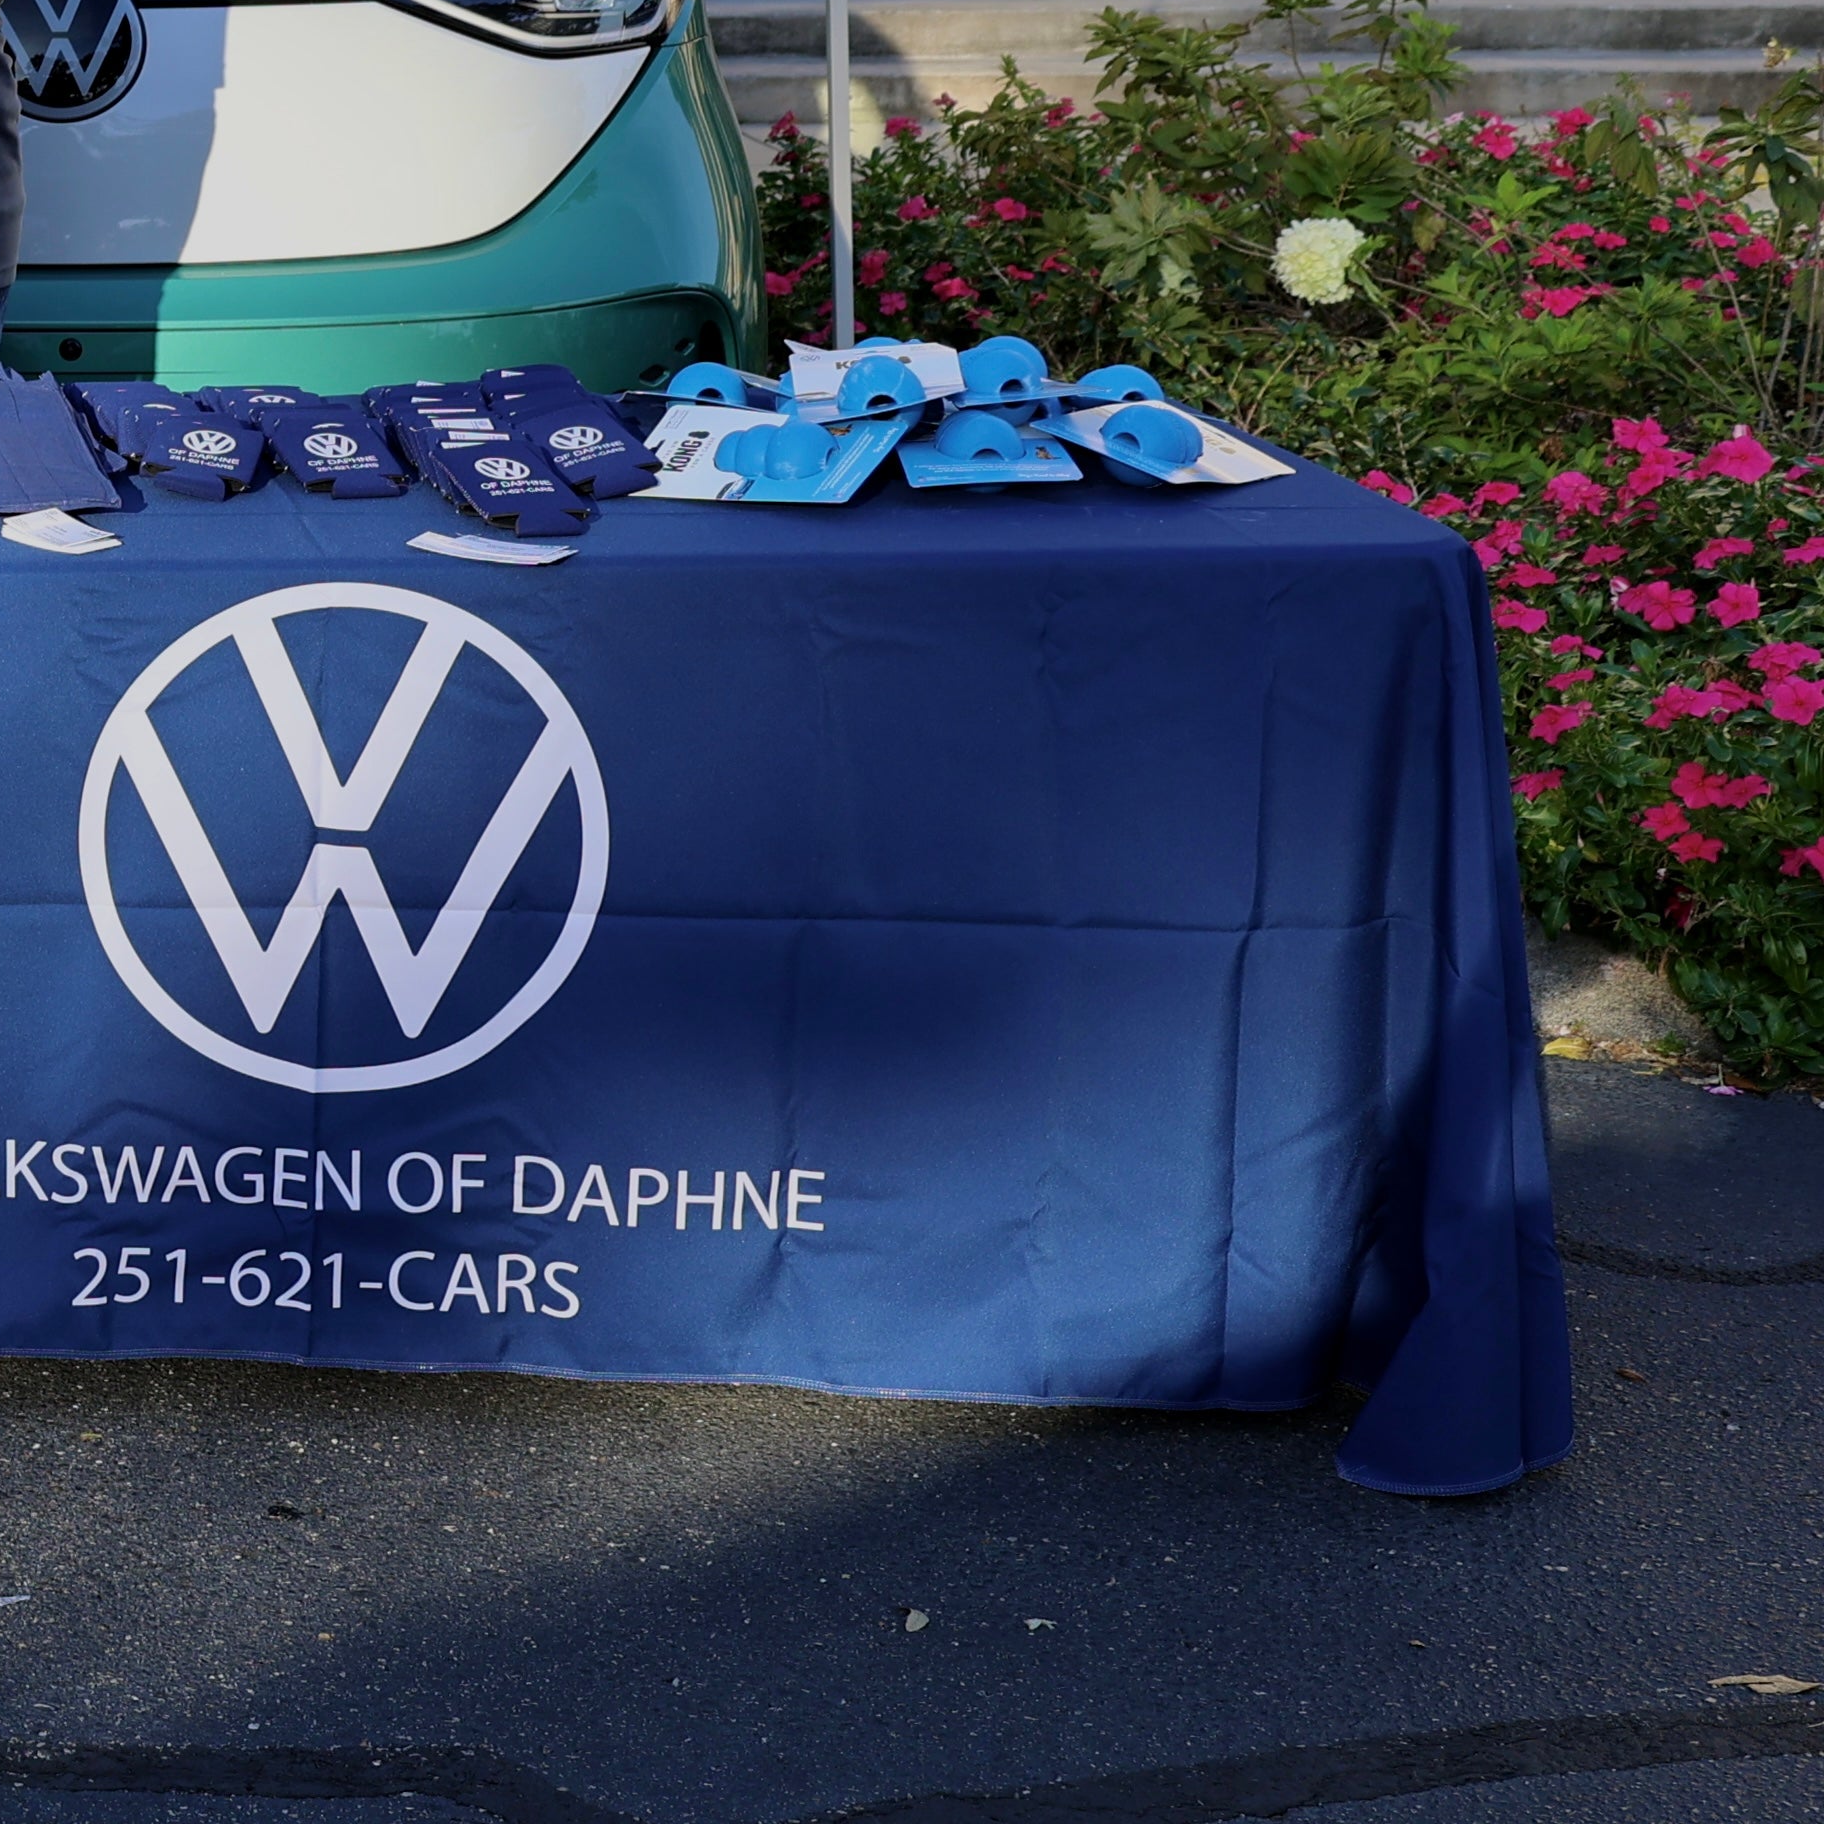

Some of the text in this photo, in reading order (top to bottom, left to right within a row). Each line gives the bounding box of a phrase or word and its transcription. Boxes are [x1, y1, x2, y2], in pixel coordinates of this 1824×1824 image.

[188, 451, 241, 466] DAPHNE
[573, 440, 625, 459] DAPHNE
[662, 439, 703, 473] KONG
[328, 455, 378, 466] DAPHNE
[500, 479, 553, 488] DAPHNE
[386, 1151, 487, 1214] OF
[510, 1154, 826, 1232] DAPHNE
[71, 1246, 581, 1320] 251-621-CARS
